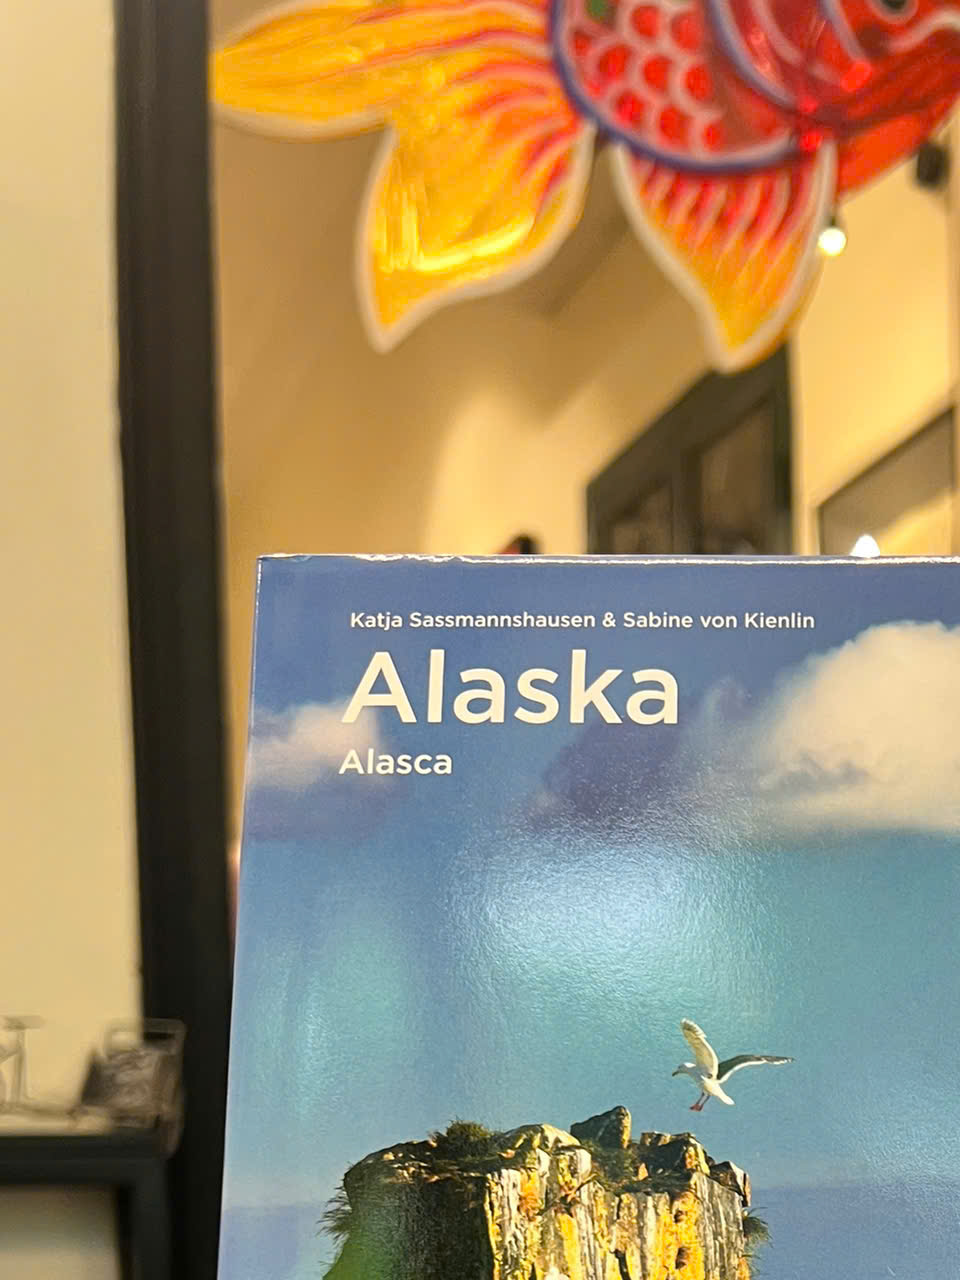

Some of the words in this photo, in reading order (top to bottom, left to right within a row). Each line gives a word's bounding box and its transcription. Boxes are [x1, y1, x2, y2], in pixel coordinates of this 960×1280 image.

[350, 611, 403, 630] Katja
[409, 611, 596, 628] Sassmannshausen
[601, 611, 616, 628] &
[623, 611, 694, 628] Sabine
[700, 615, 738, 628] von
[744, 611, 815, 629] Kienlin
[340, 648, 679, 725] Alaska
[338, 747, 453, 775] Alasca
